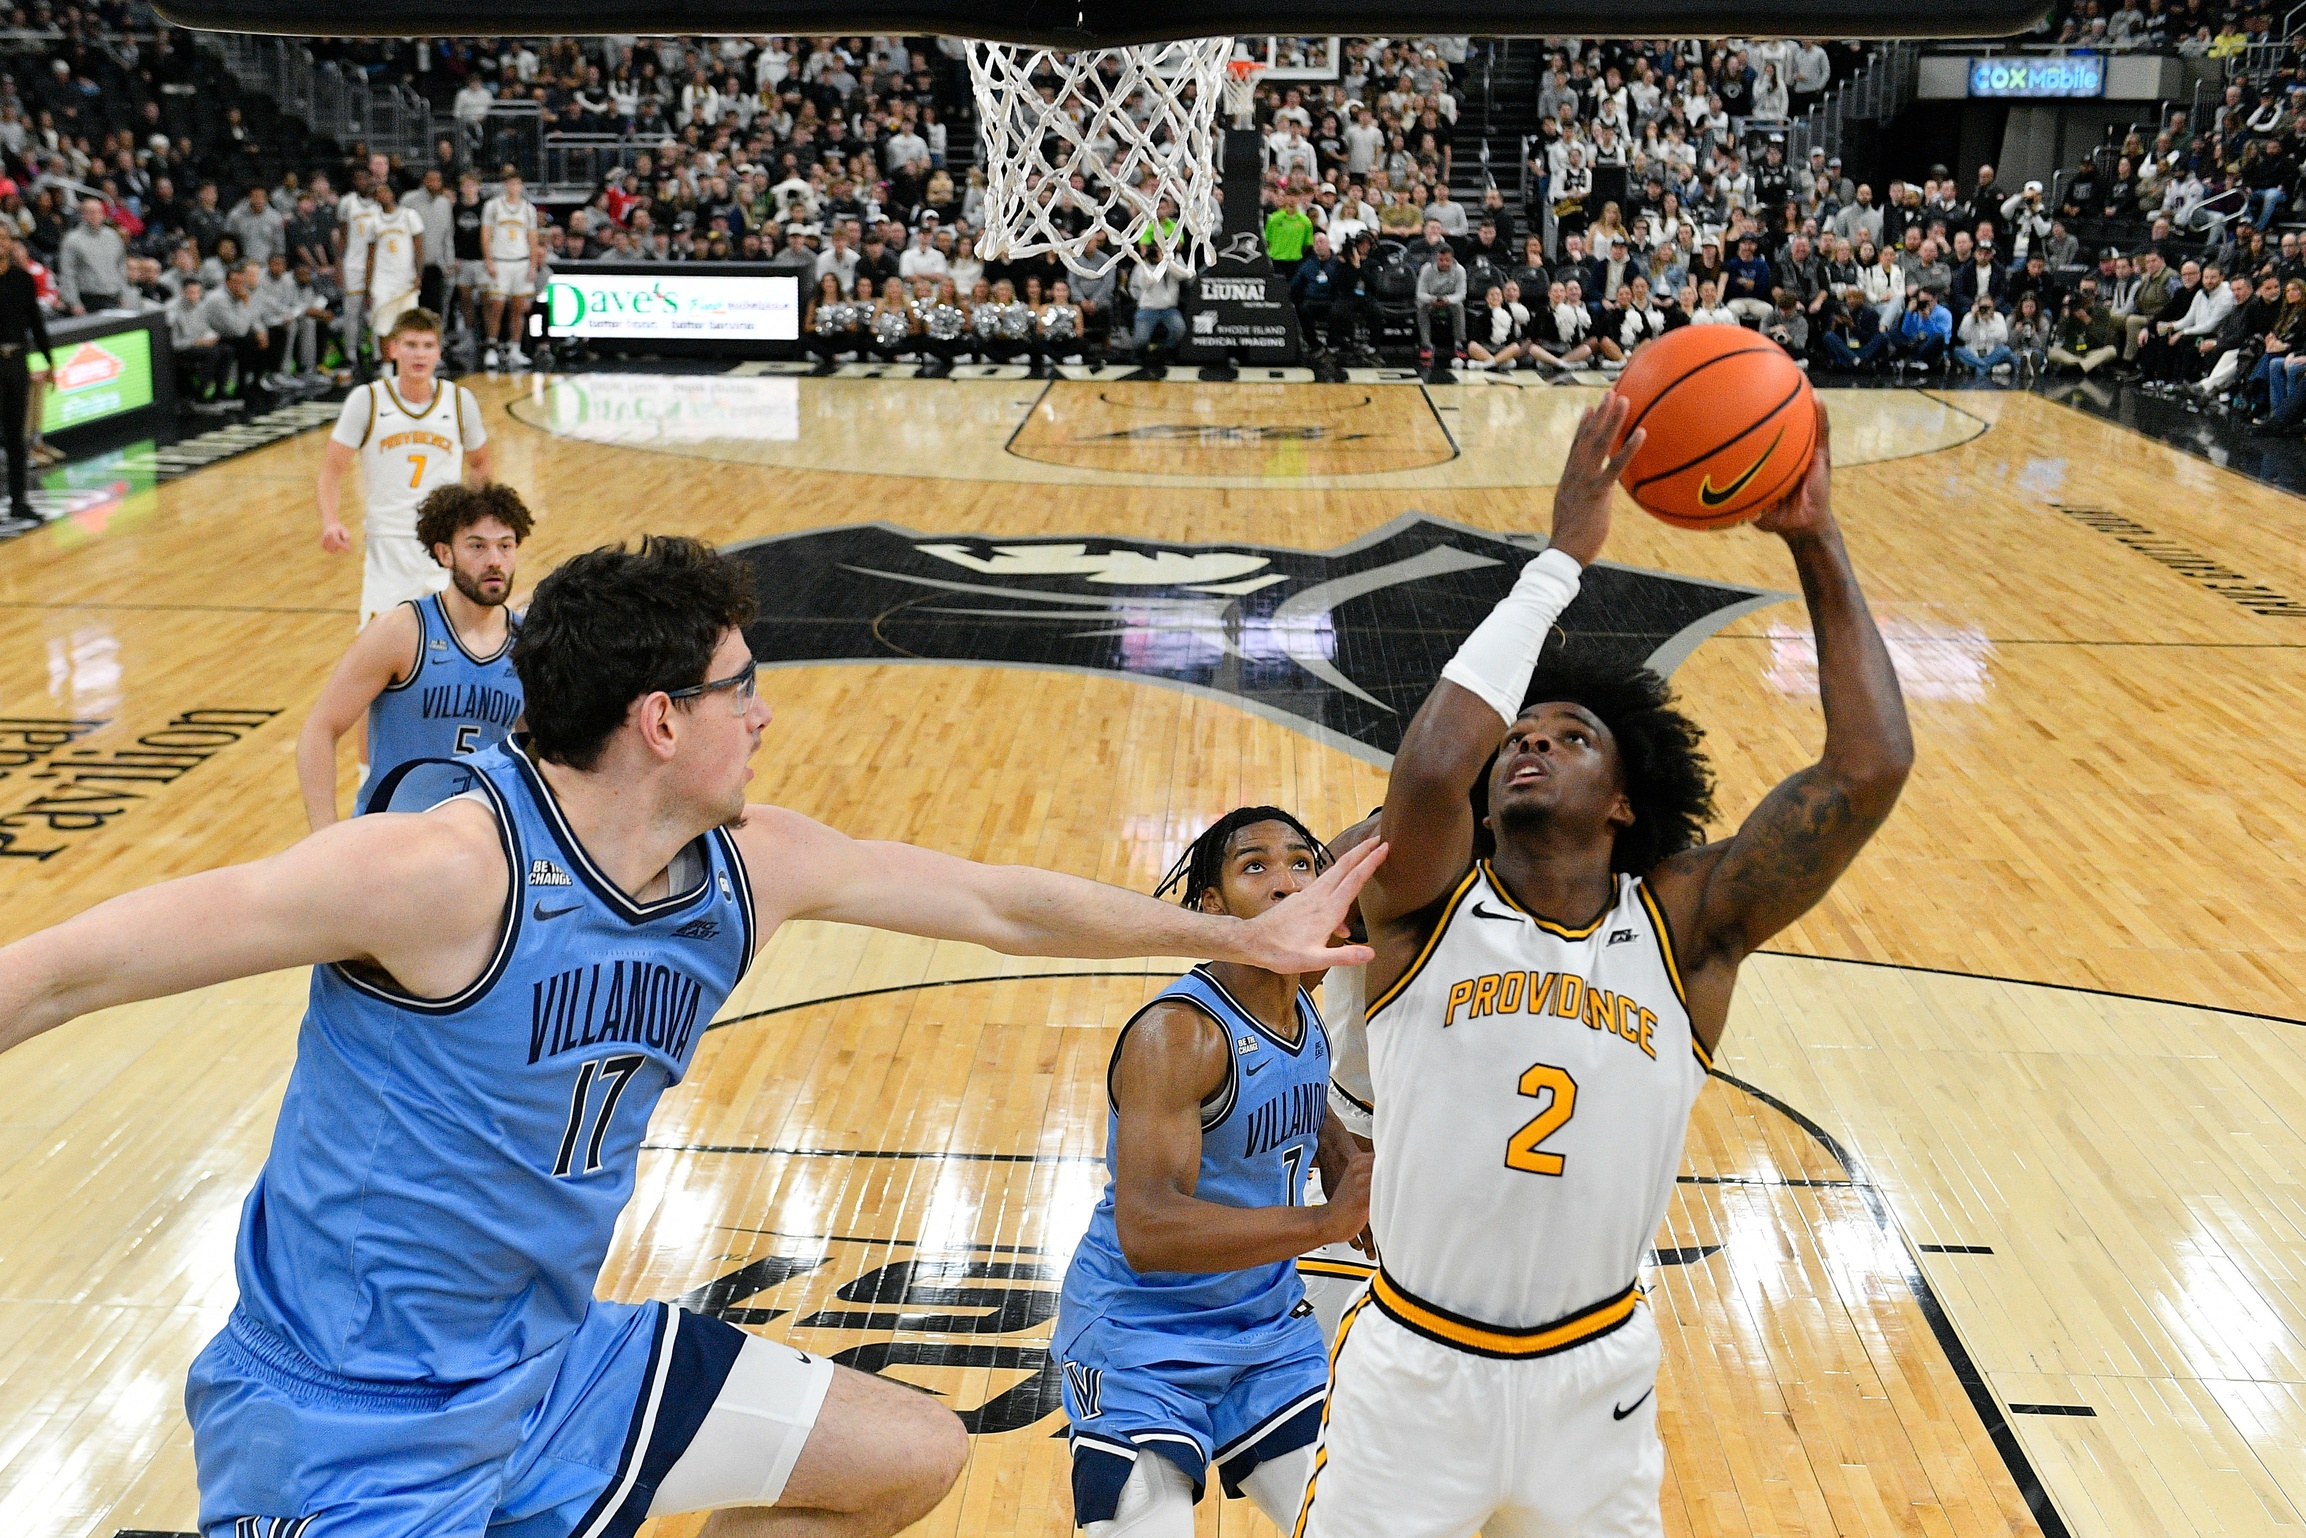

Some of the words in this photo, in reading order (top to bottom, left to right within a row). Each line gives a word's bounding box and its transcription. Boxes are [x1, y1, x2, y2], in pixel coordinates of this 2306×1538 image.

[1974, 66, 2027, 90] COX
[546, 282, 680, 327] Dave's
[407, 455, 427, 488] 7
[453, 724, 482, 755] 5
[528, 872, 573, 885] CHANGE
[532, 860, 549, 873] BE
[527, 960, 702, 1066] VILLANOVA
[552, 1054, 647, 1178] 17
[1244, 1081, 1328, 1159] VILLANO
[1504, 1062, 1578, 1177] 2
